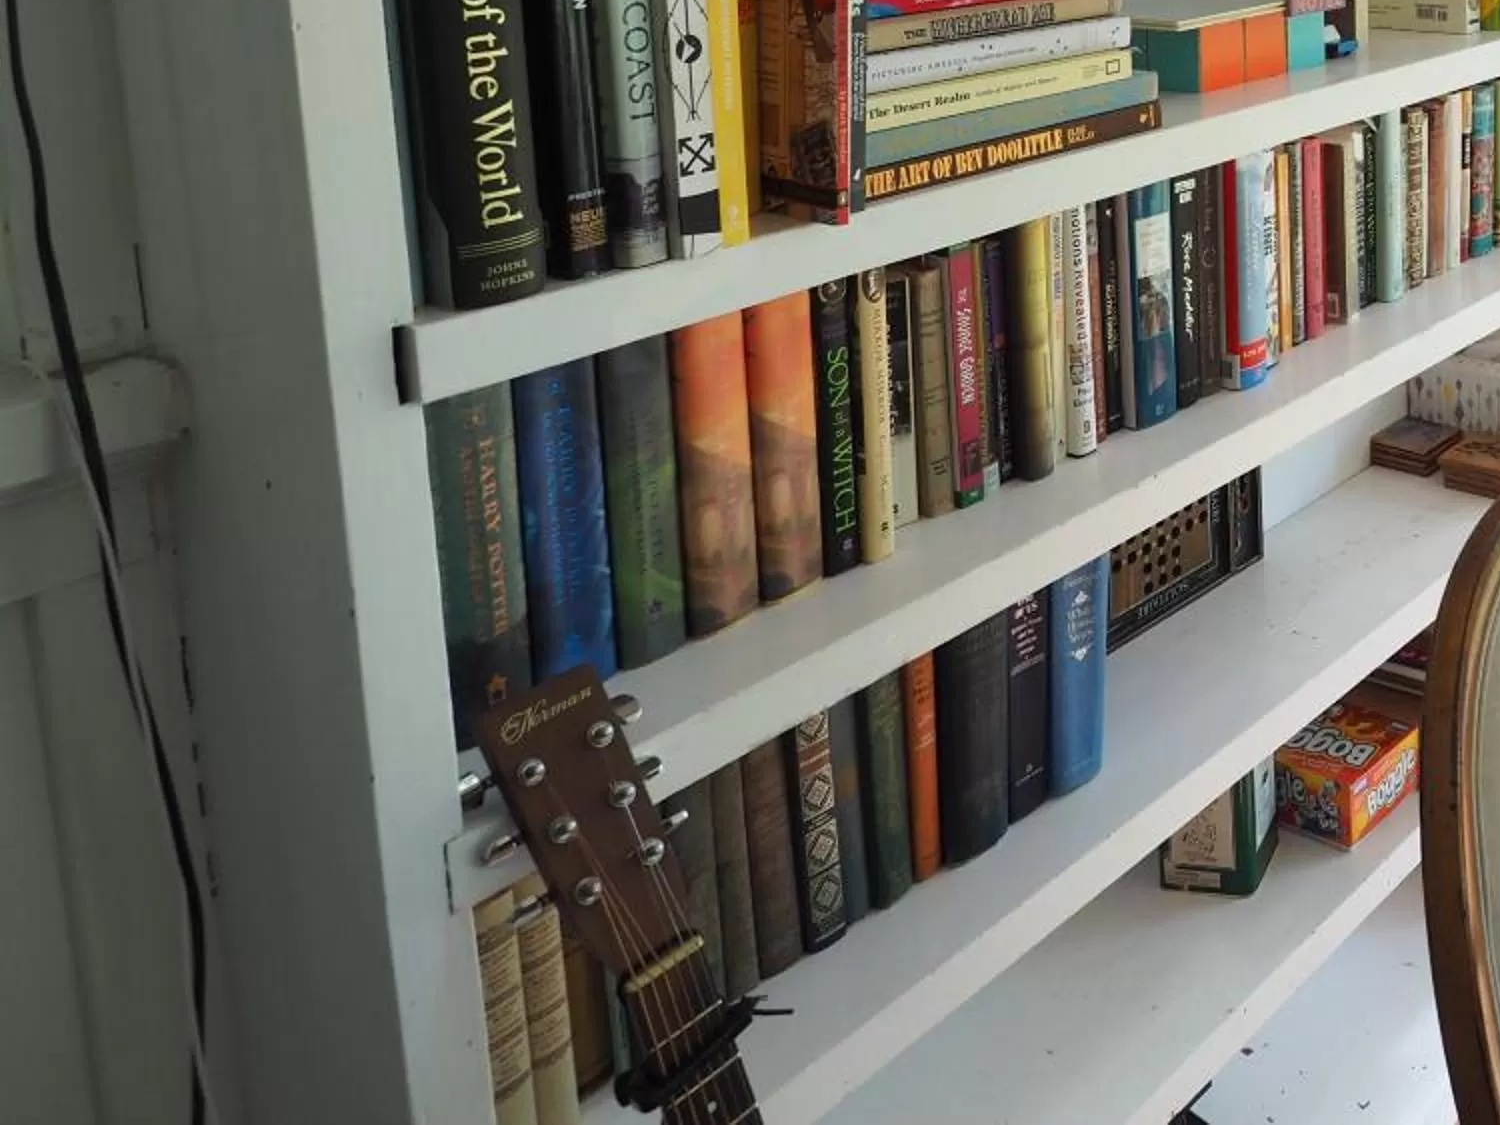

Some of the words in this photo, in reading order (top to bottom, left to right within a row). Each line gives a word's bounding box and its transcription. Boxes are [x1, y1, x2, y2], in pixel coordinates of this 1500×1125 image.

[466, 33, 510, 101] the
[623, 4, 657, 125] COAST
[904, 28, 928, 41] THE
[869, 107, 890, 120] The
[893, 98, 931, 114] Desert
[935, 92, 971, 107] Realm
[471, 97, 524, 229] World
[865, 168, 895, 198] THE
[898, 161, 932, 189] ART
[932, 158, 953, 181] OF
[955, 148, 983, 175] BEV
[987, 127, 1064, 167] DOOLITTLE
[1179, 230, 1194, 274] Rose
[1073, 270, 1088, 340] Revealed
[1181, 276, 1197, 344] Madder
[826, 347, 850, 414] SON
[478, 436, 502, 532] HARRY
[829, 439, 857, 535] WITCH
[486, 539, 509, 636] POTTER
[1283, 726, 1378, 768] Bogg
[1367, 748, 1417, 817] Boggle
